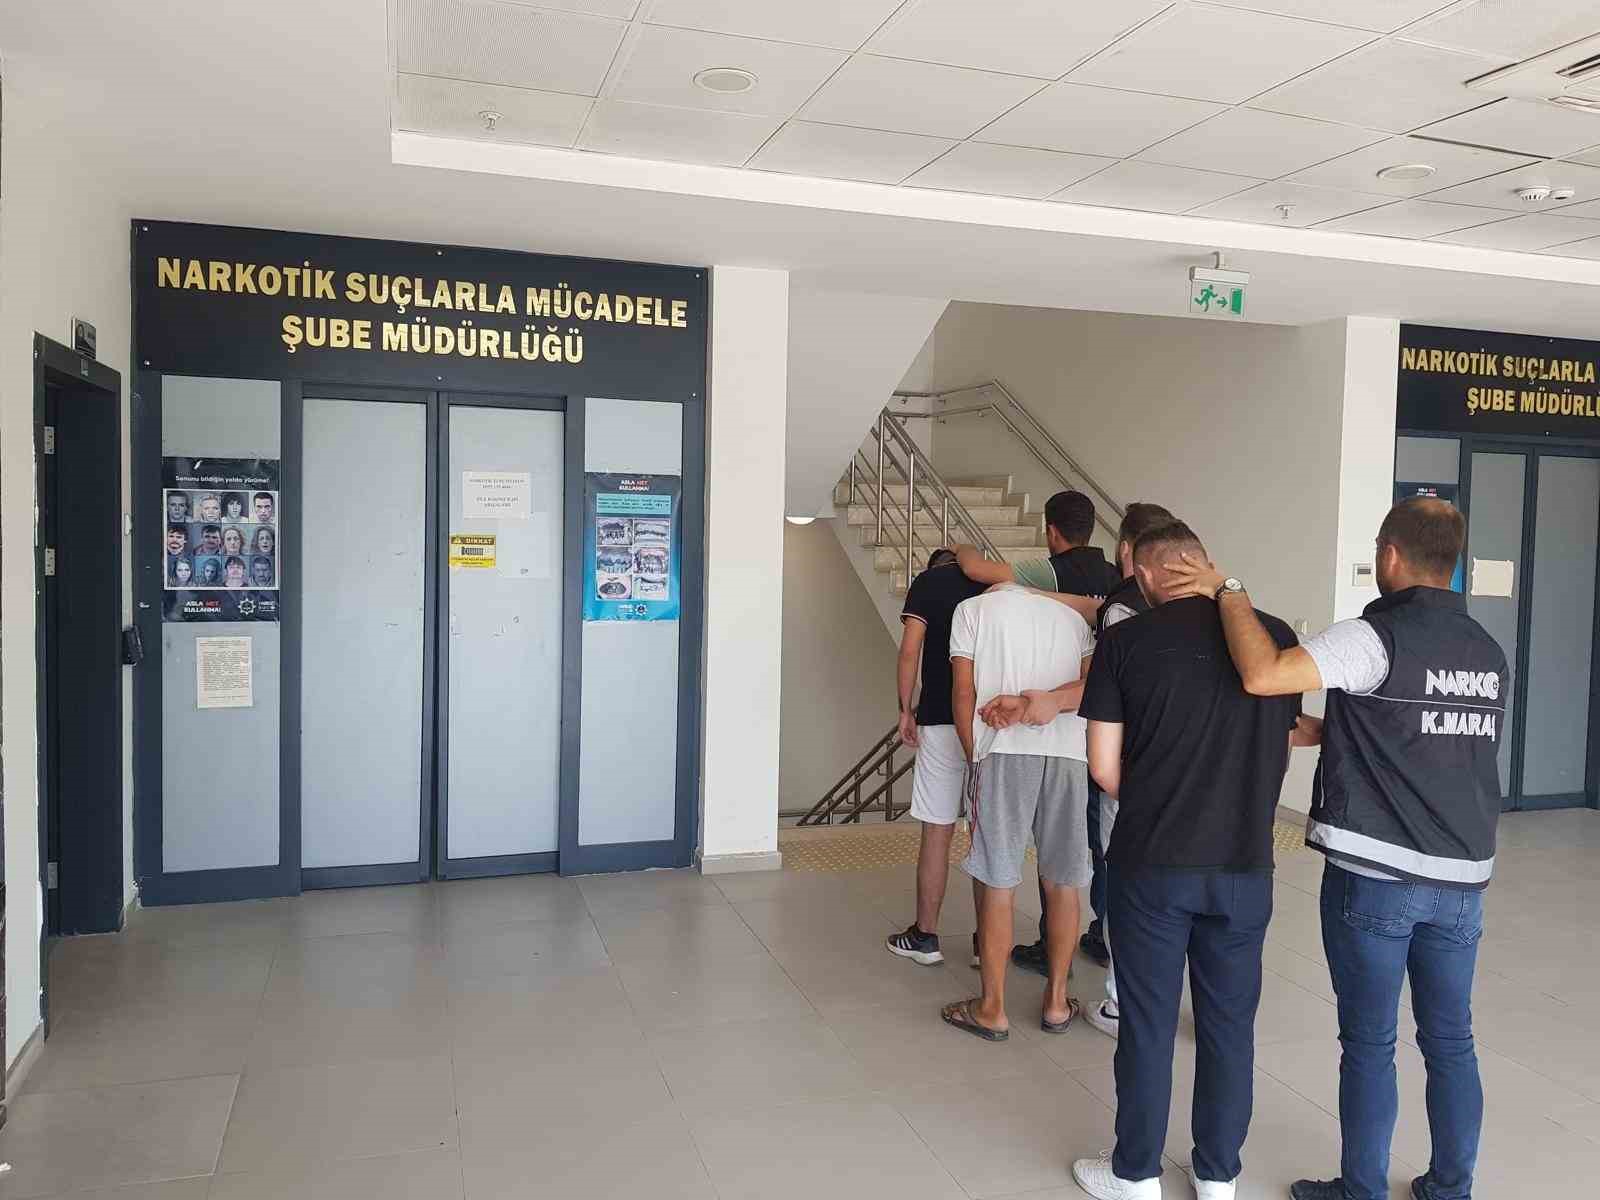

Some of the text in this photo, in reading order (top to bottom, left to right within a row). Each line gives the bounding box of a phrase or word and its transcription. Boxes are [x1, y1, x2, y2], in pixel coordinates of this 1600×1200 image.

[157, 257, 688, 328] NARKOTİK SUÇLARLA MÜCADELE
[281, 314, 584, 364] ŞUBE MÜDÜRLÜĞÜ
[1402, 347, 1595, 384] NARKOTİK SUÇLARLA
[1467, 387, 1516, 416] ŞUBE
